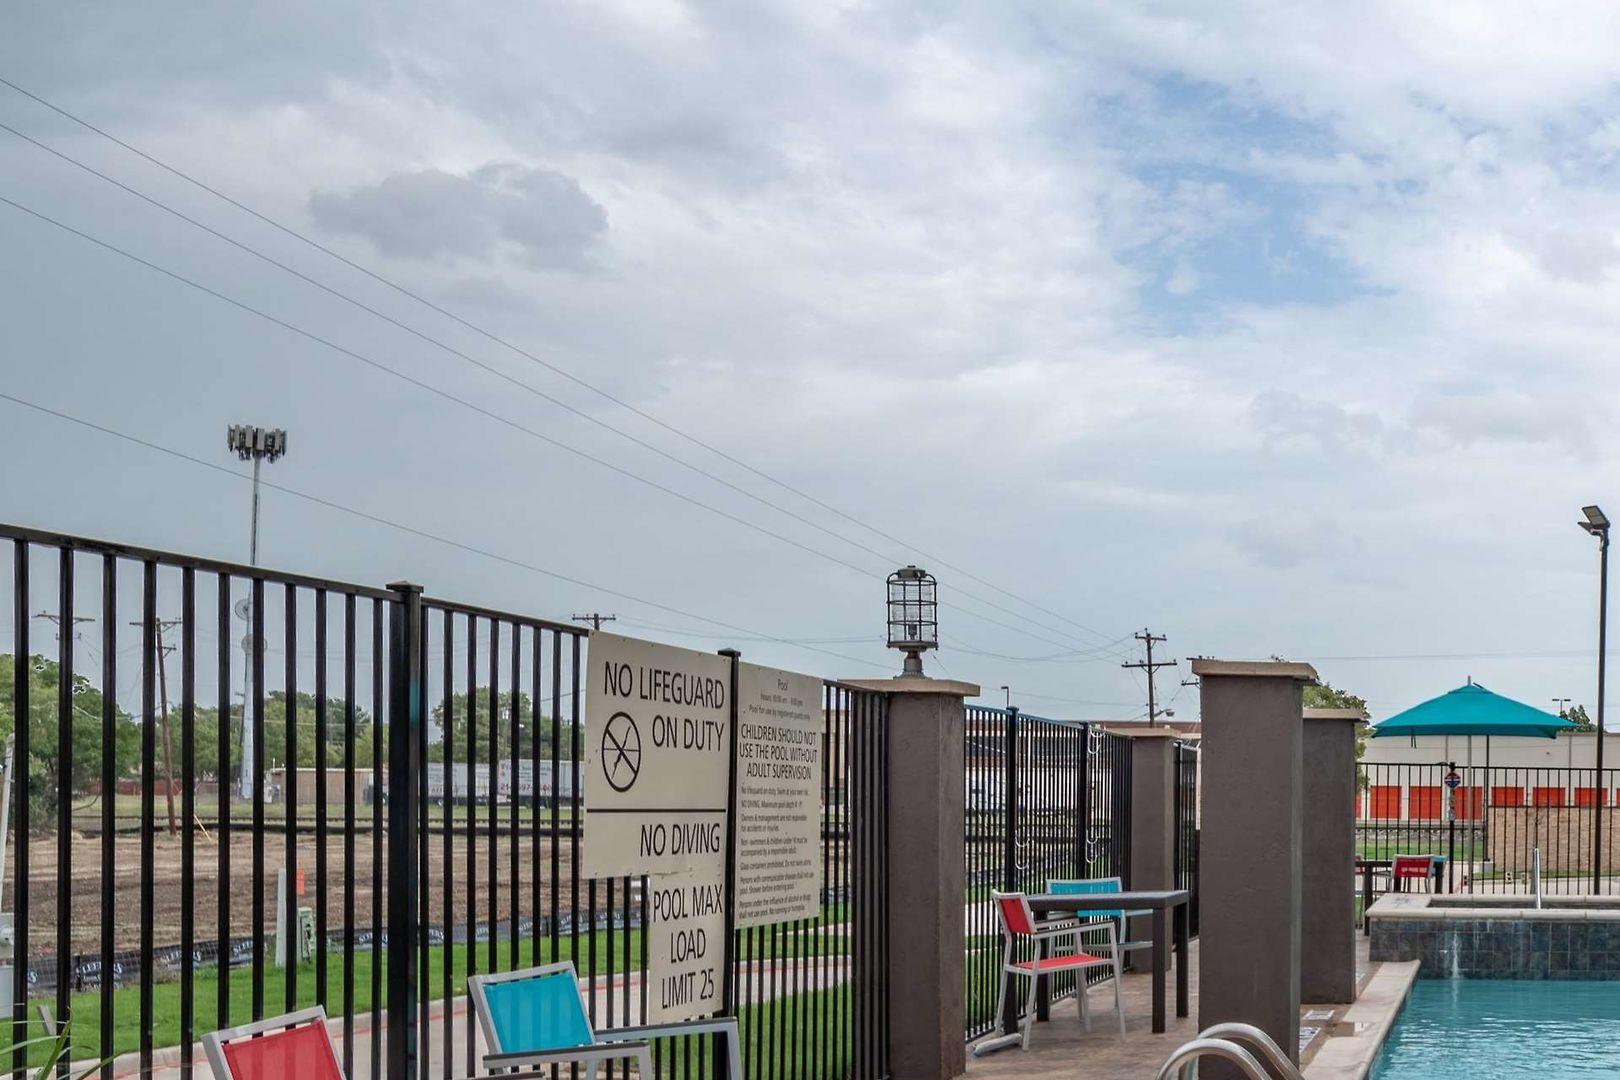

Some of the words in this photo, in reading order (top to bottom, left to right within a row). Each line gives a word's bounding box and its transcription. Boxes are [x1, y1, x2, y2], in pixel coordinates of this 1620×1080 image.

[604, 661, 633, 698] NO
[640, 667, 725, 709] LIFEGUARD
[652, 715, 677, 748] ON
[684, 718, 725, 751] DUTY
[741, 723, 777, 742] CHILDREN
[778, 728, 802, 744] SHOULD
[804, 731, 816, 746] NOT
[739, 743, 753, 758] USE
[755, 744, 769, 760] THE
[770, 745, 789, 761] POOL
[790, 748, 818, 763] WITHOUT
[746, 762, 772, 778] ADULT
[772, 763, 812, 780] SUPERVISION
[640, 824, 666, 857] NO
[672, 822, 720, 855] DIVING
[653, 888, 688, 923] POOL
[692, 883, 723, 917] MAX
[670, 928, 706, 964] LOAD
[662, 972, 696, 1010] LIMIT
[700, 968, 714, 1001] 25
